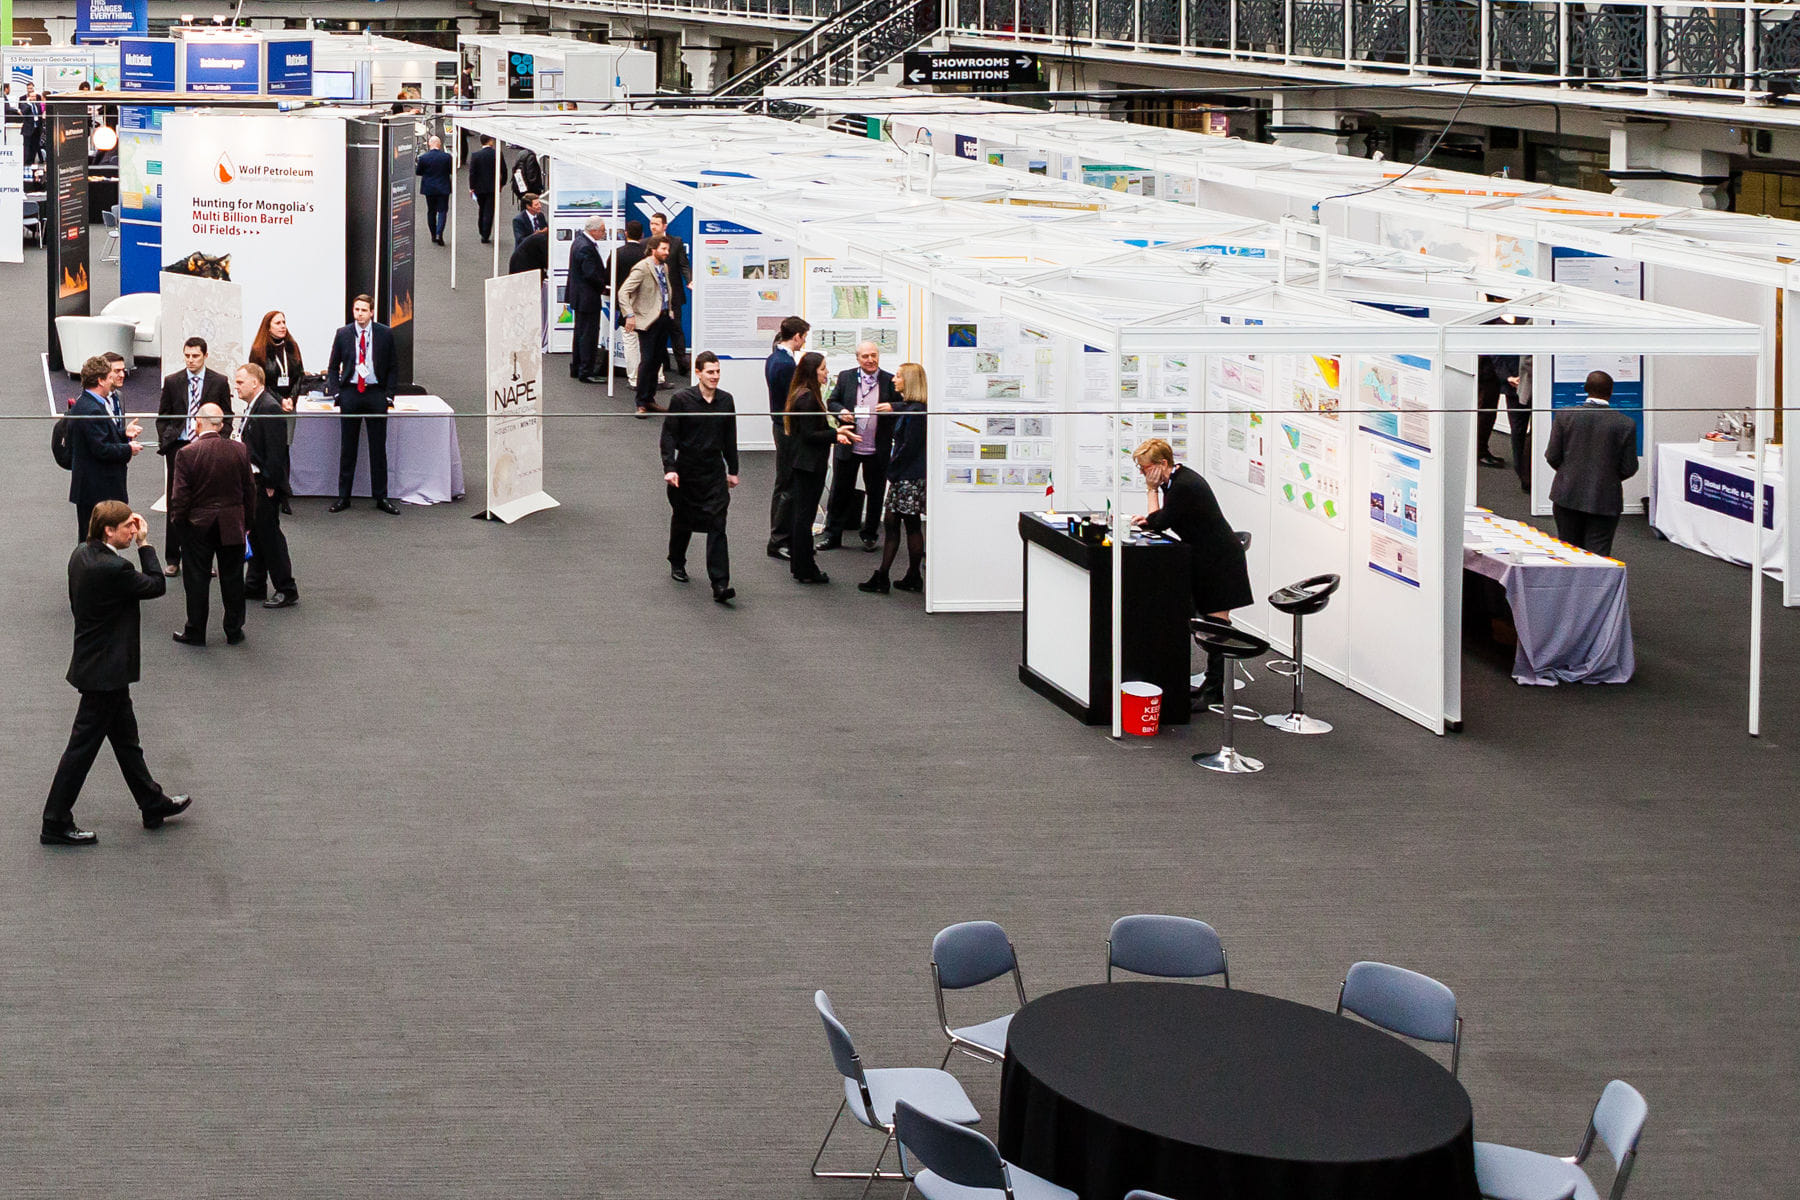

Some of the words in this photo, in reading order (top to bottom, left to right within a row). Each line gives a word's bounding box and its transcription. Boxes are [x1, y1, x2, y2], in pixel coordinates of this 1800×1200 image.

[932, 57, 1010, 68] SHOWROOMS
[932, 70, 1010, 81] EXHIBITIONS
[239, 165, 262, 175] Wolf
[263, 166, 314, 177] Petroleum
[192, 197, 235, 212] Hunting
[237, 198, 253, 210] for
[255, 200, 314, 214] Mongolia's
[192, 210, 221, 222] Multi
[223, 212, 258, 223] Billion
[260, 213, 293, 225] Barrel
[192, 224, 207, 235] Oil
[209, 224, 241, 236] Fields
[494, 379, 537, 411] NAPE
[495, 425, 517, 435] HOUSTON
[1144, 704, 1161, 714] KEE
